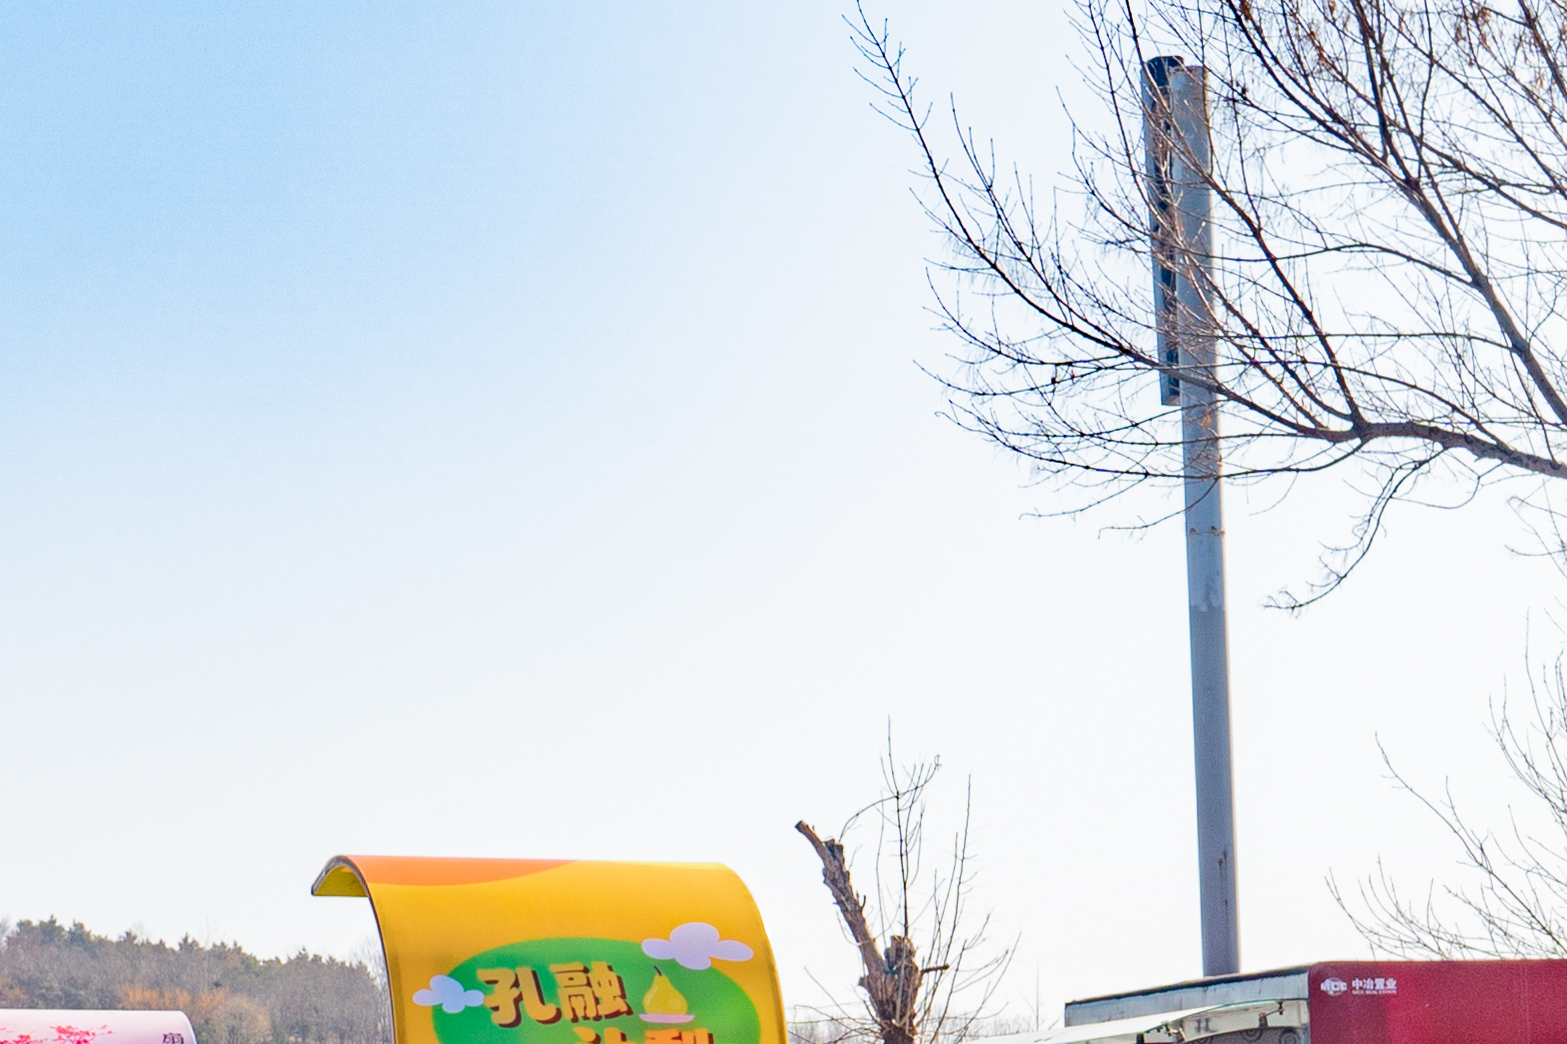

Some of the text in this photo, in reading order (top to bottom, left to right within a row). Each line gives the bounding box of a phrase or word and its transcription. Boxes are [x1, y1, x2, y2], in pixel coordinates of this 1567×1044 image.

[477, 961, 633, 1028] 孔融
[1352, 977, 1397, 990] 中冶置业
